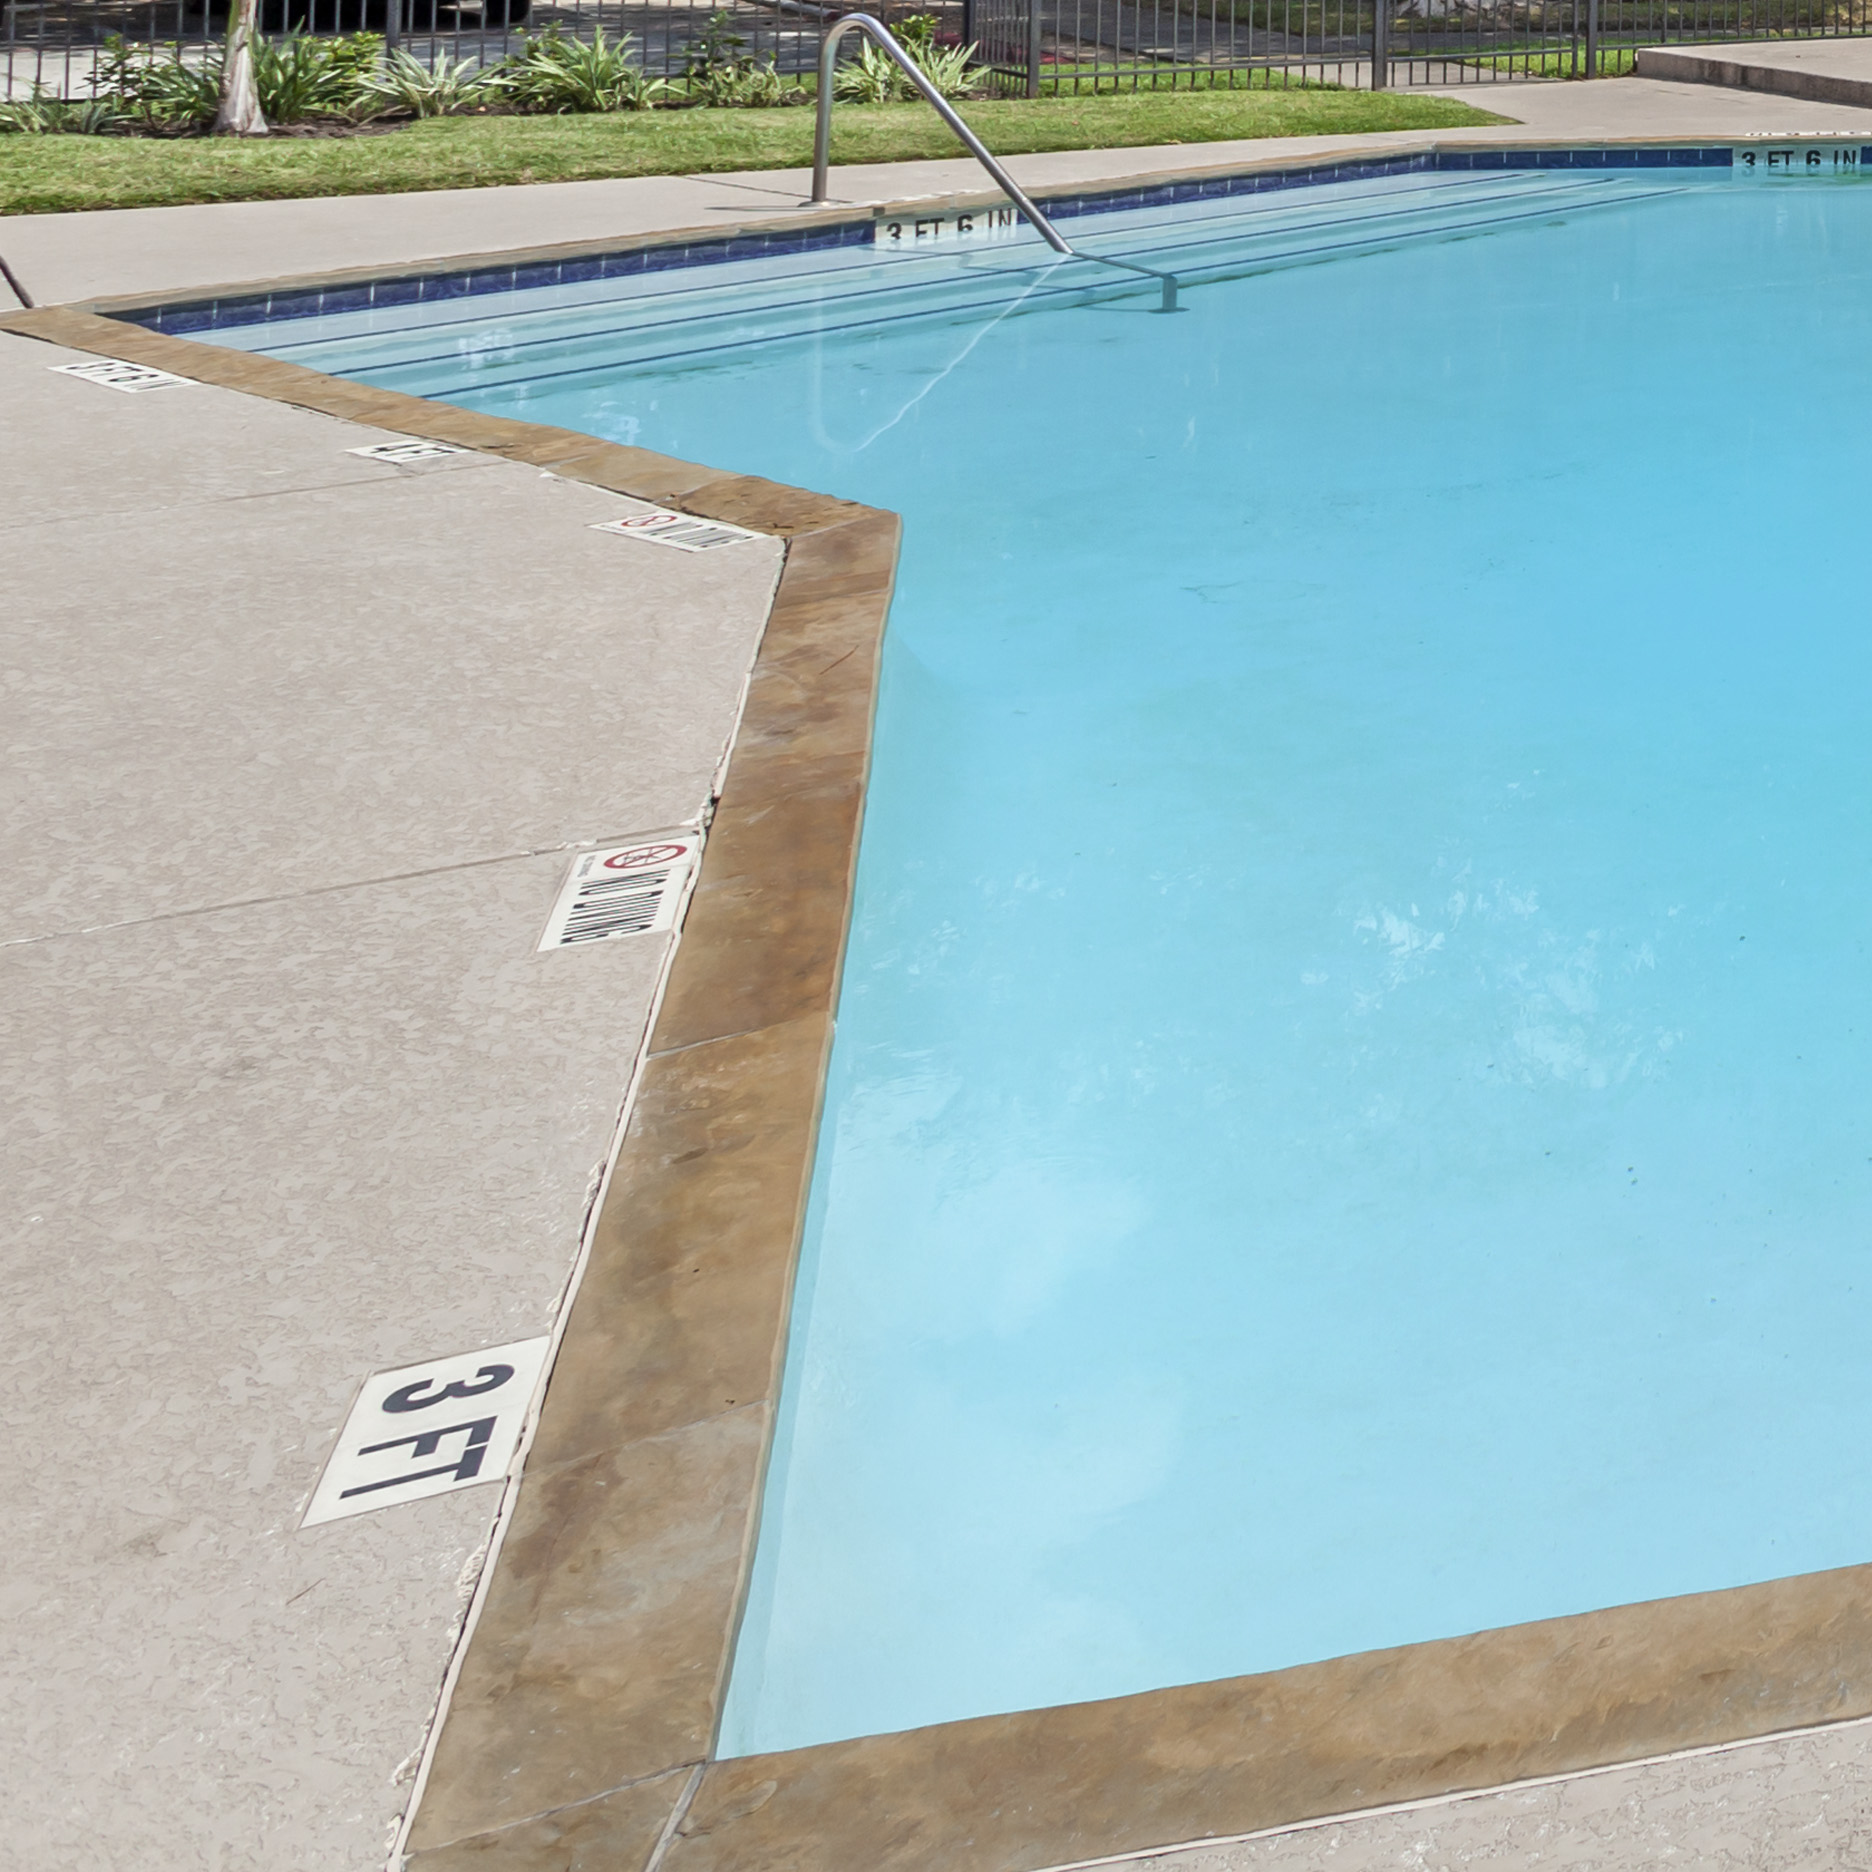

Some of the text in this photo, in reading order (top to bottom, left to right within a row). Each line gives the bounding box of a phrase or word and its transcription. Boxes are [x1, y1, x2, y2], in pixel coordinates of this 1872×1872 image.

[1741, 150, 1856, 167] 3 FT 6 IN
[886, 222, 902, 240] 3
[915, 217, 944, 237] FT
[988, 208, 1011, 228] IN
[559, 868, 671, 945] NO DIVING
[339, 1364, 515, 1500] 3 FT
